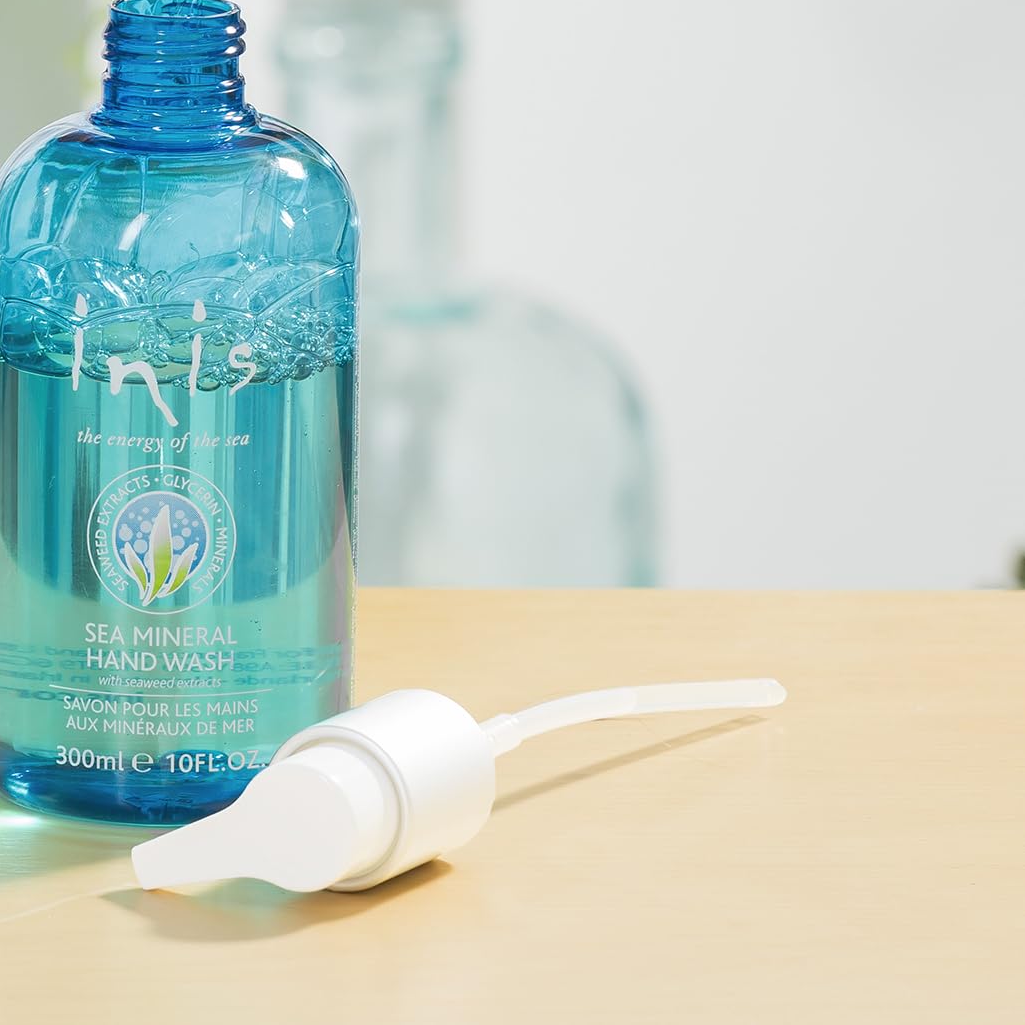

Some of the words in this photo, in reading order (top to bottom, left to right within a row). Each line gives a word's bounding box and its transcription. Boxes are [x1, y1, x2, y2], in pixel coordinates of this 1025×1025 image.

[77, 426, 102, 445] the
[106, 434, 164, 453] energy
[170, 432, 191, 453] of
[193, 431, 219, 447] the
[225, 433, 251, 447] sea
[96, 474, 151, 527] EXTRACTS
[163, 474, 223, 516] GLYCERIN
[94, 527, 130, 592] SEAWEED
[191, 526, 228, 593] MINERALS
[84, 622, 125, 645] SEA
[133, 625, 238, 647] MINERAL
[86, 647, 158, 671] HAND
[162, 650, 235, 672] WASH
[98, 674, 123, 686] with
[124, 677, 175, 689] seaweed
[176, 677, 222, 689] extracts
[63, 695, 118, 715] SAVON
[122, 701, 170, 717] POUR
[175, 702, 201, 717] LES
[206, 699, 259, 716] MAINS
[65, 715, 99, 732] AUX
[103, 718, 192, 736] MINÉRAUX
[196, 721, 217, 735] DE
[222, 718, 255, 734] MER
[55, 745, 124, 771] 300ml
